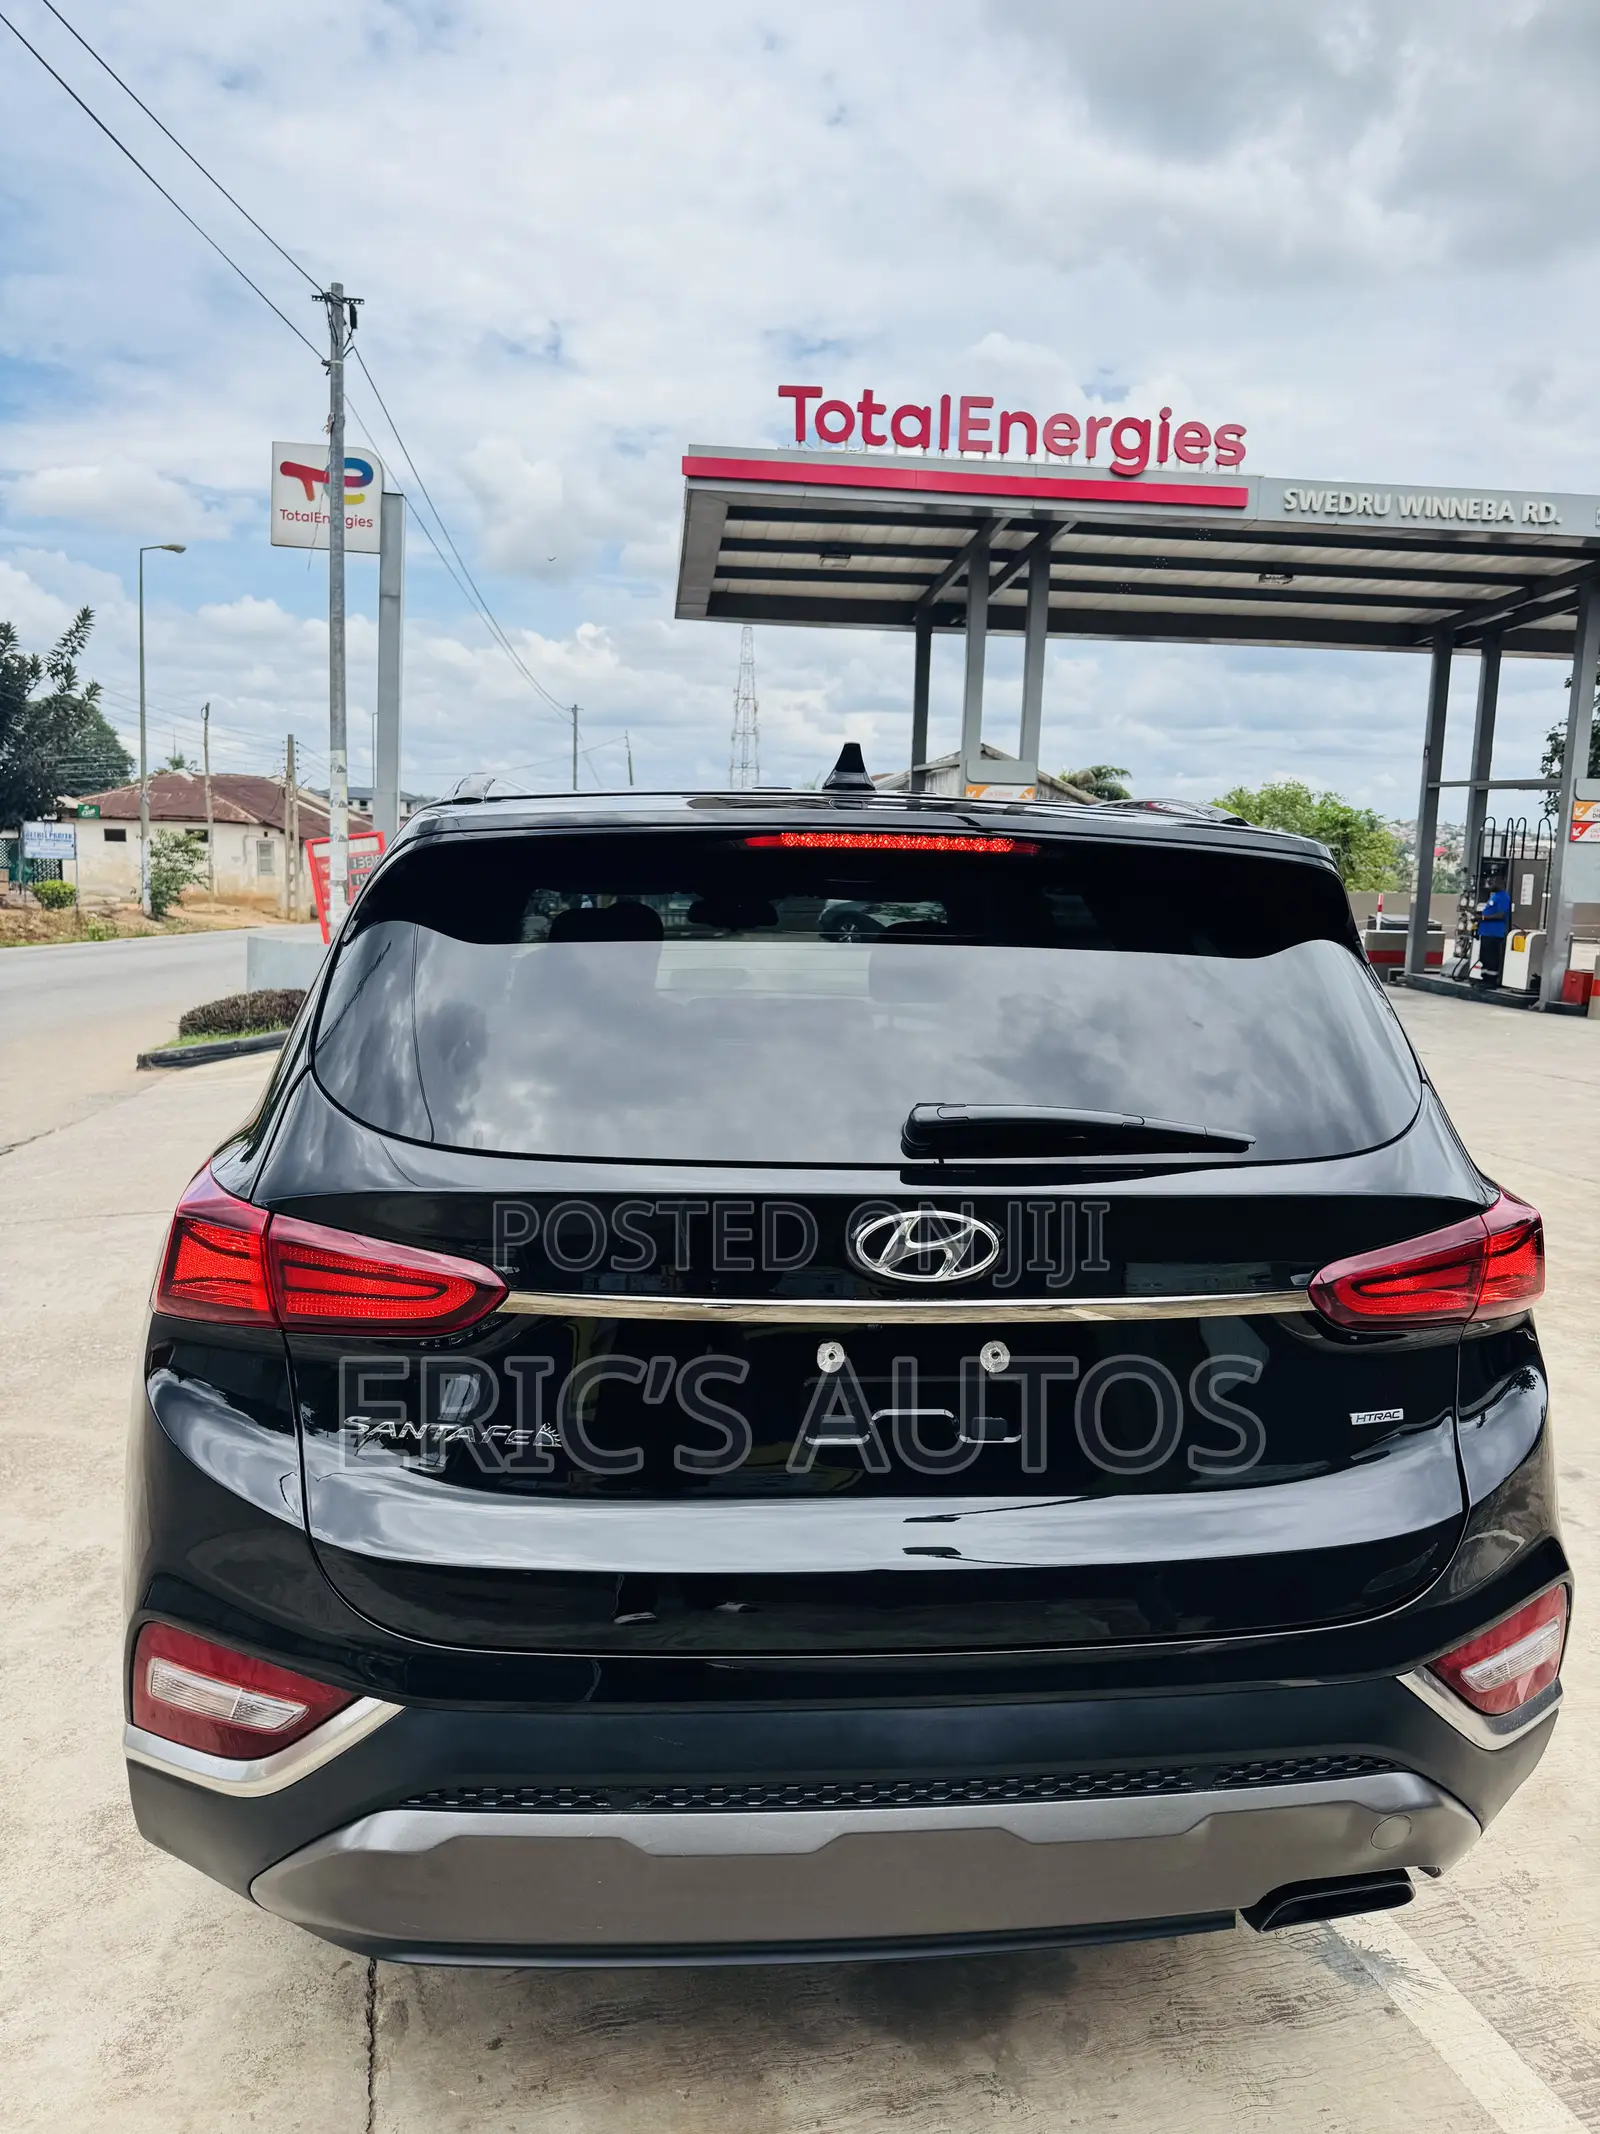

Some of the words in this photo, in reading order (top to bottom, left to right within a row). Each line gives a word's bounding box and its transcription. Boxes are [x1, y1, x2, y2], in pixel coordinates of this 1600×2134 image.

[778, 385, 1246, 476] TotalEnergies
[279, 508, 373, 529] TotalEngies
[1284, 487, 1392, 516] SWEDRU
[1399, 493, 1516, 523] WINNEBA
[1522, 501, 1563, 524] RD.
[1356, 1411, 1400, 1423] HTRAC
